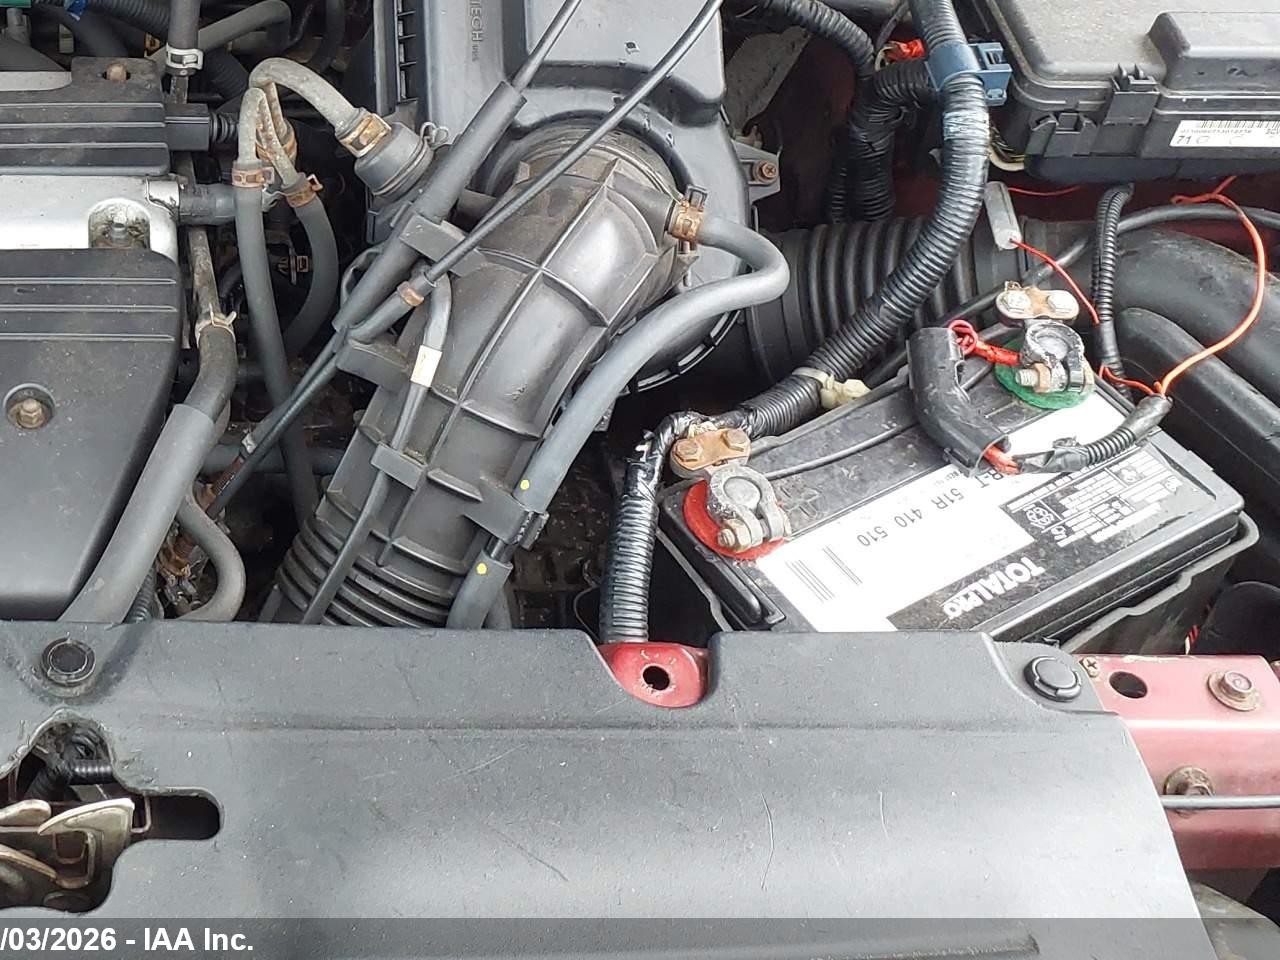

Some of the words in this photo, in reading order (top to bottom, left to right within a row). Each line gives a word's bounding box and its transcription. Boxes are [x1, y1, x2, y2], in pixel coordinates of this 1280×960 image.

[931, 488, 965, 509] 51R
[894, 508, 923, 528] 410
[857, 526, 888, 546] 510
[942, 557, 1046, 619] TOTALPRO
